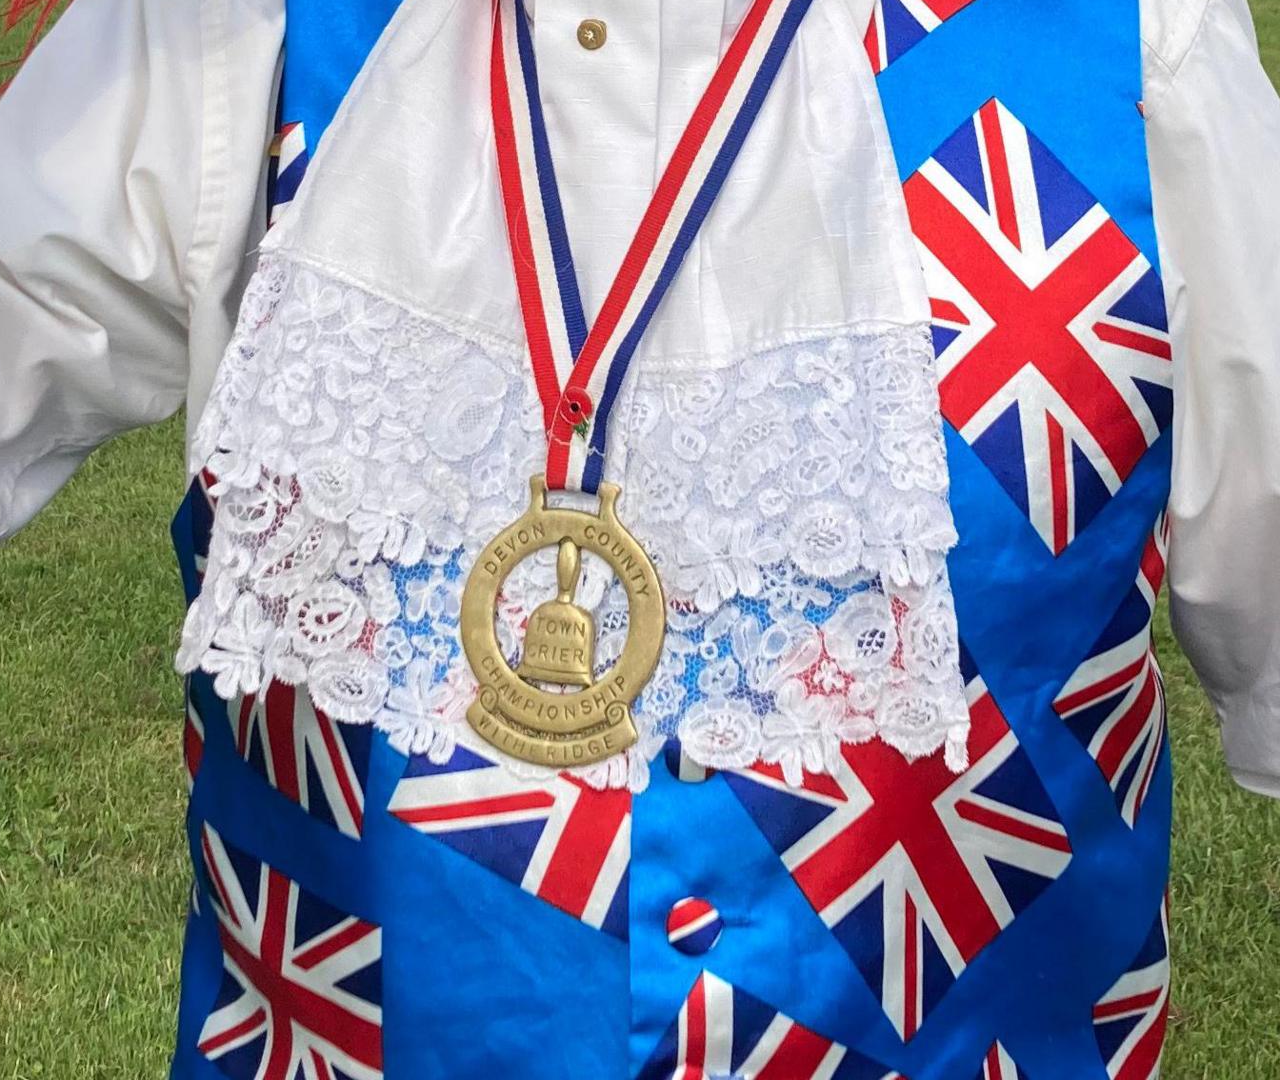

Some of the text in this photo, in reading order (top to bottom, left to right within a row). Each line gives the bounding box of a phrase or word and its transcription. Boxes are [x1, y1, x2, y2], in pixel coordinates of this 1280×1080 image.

[483, 521, 650, 597] DEVON COUNTY
[534, 617, 586, 638] TOWN
[527, 642, 585, 665] CRIER
[481, 655, 627, 722] CHAMPIONSHIP
[477, 715, 615, 761] WITHERIDGE
